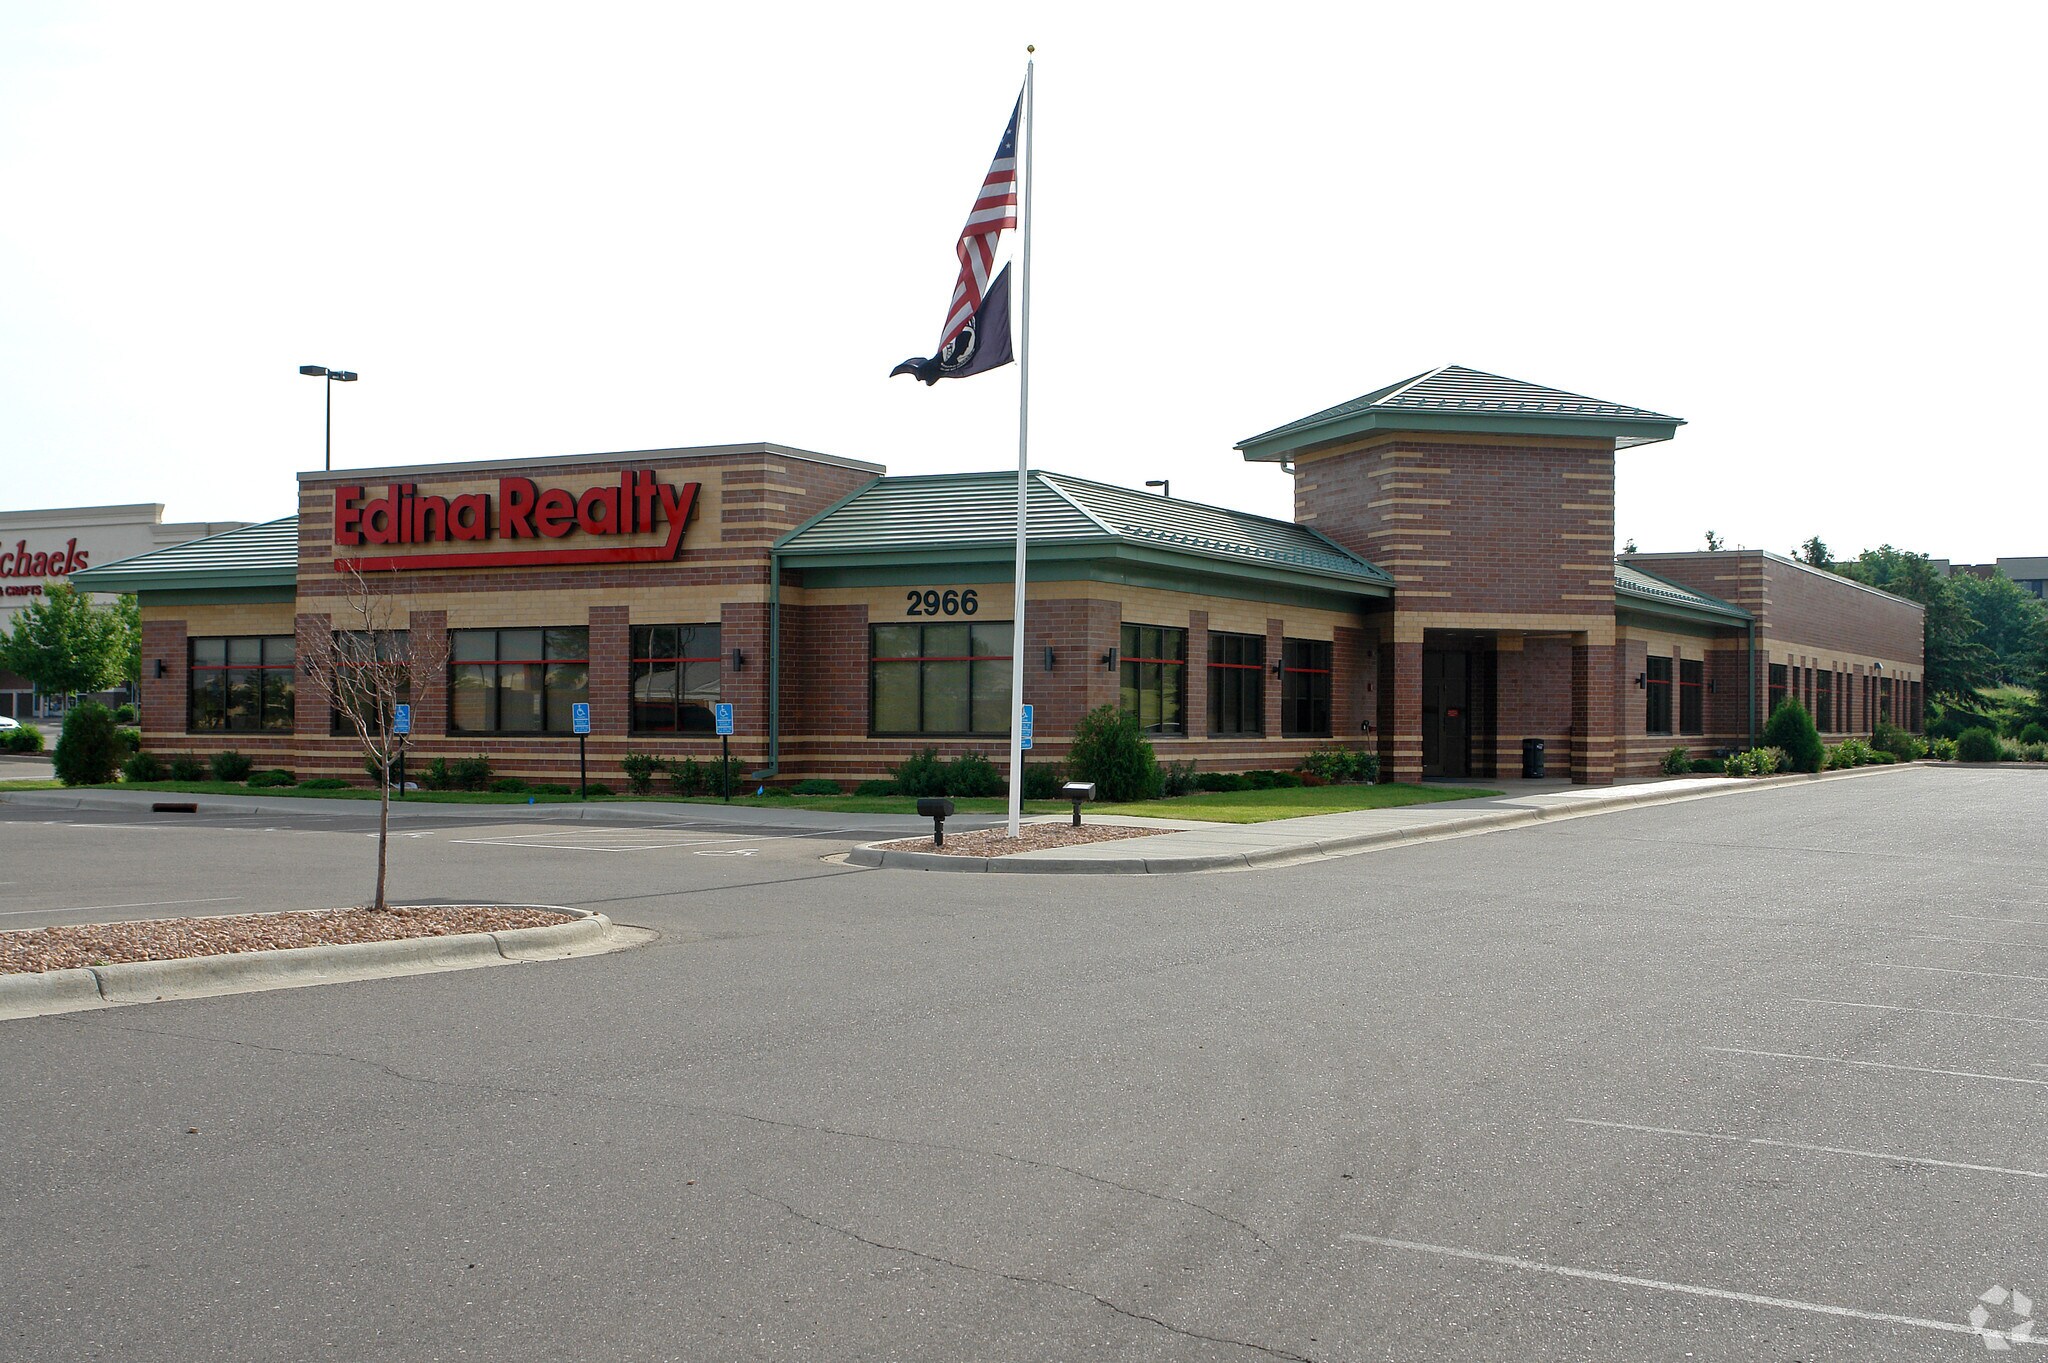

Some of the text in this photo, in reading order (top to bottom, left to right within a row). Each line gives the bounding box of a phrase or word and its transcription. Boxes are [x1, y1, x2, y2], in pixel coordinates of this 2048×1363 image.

[335, 470, 702, 560] Edina Realty
[0, 537, 89, 578] chaels
[5, 585, 42, 596] CRAFTS
[906, 589, 979, 616] 2966
